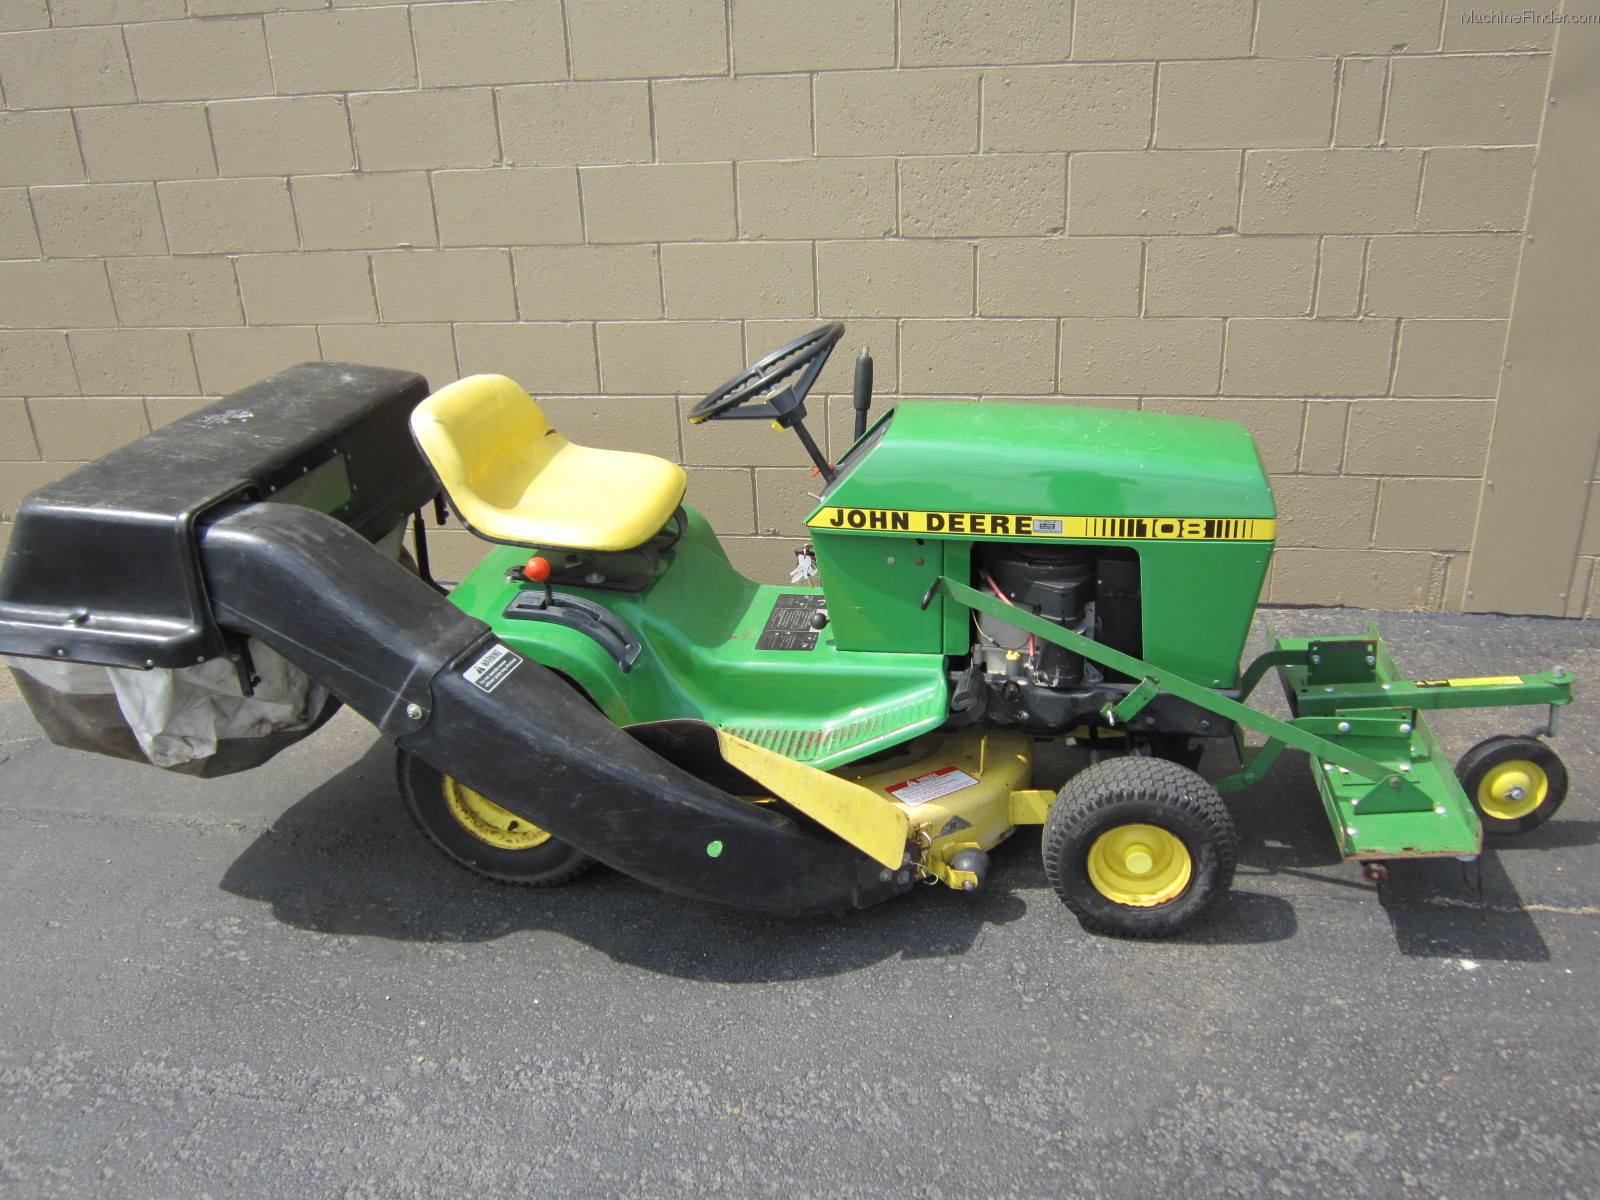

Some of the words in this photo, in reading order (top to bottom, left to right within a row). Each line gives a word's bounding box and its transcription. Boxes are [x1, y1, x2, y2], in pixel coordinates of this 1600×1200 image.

[829, 509, 909, 530] JOHN
[926, 513, 1033, 535] DEERE
[1140, 518, 1207, 539] 108
